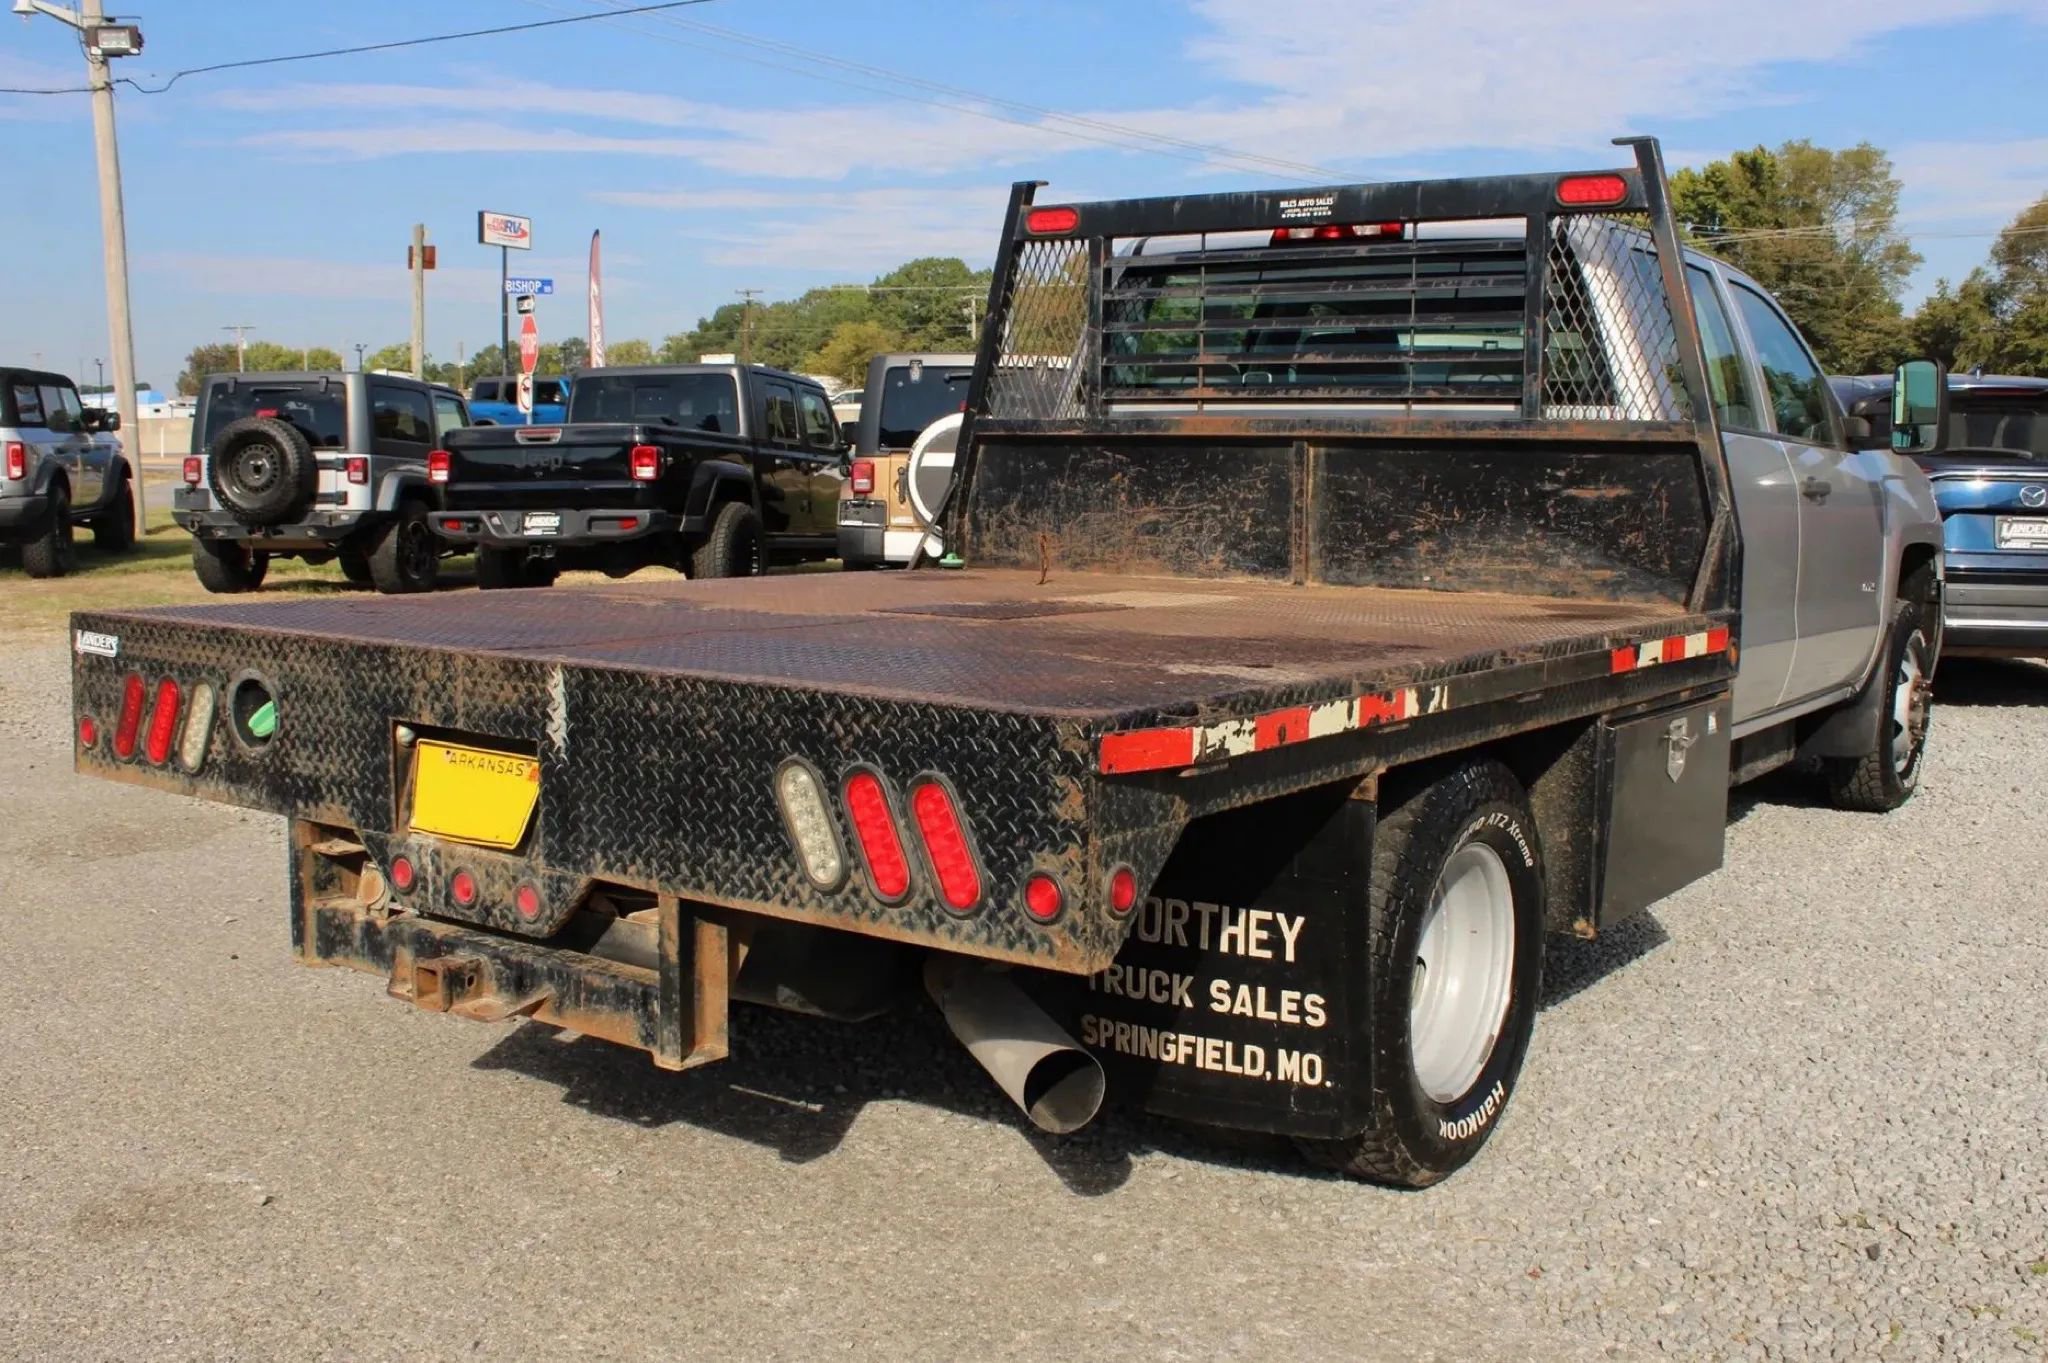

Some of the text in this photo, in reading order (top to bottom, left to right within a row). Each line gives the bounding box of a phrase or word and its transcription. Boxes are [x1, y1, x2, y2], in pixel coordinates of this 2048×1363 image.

[1298, 198, 1315, 206] AUTO
[1316, 197, 1333, 205] SALES
[505, 280, 542, 293] BISHOP
[449, 751, 525, 777] ARKANSAS
[1506, 820, 1534, 868] Xtreme
[1136, 896, 1306, 963] ORTHEY
[1209, 978, 1328, 1028] SALES
